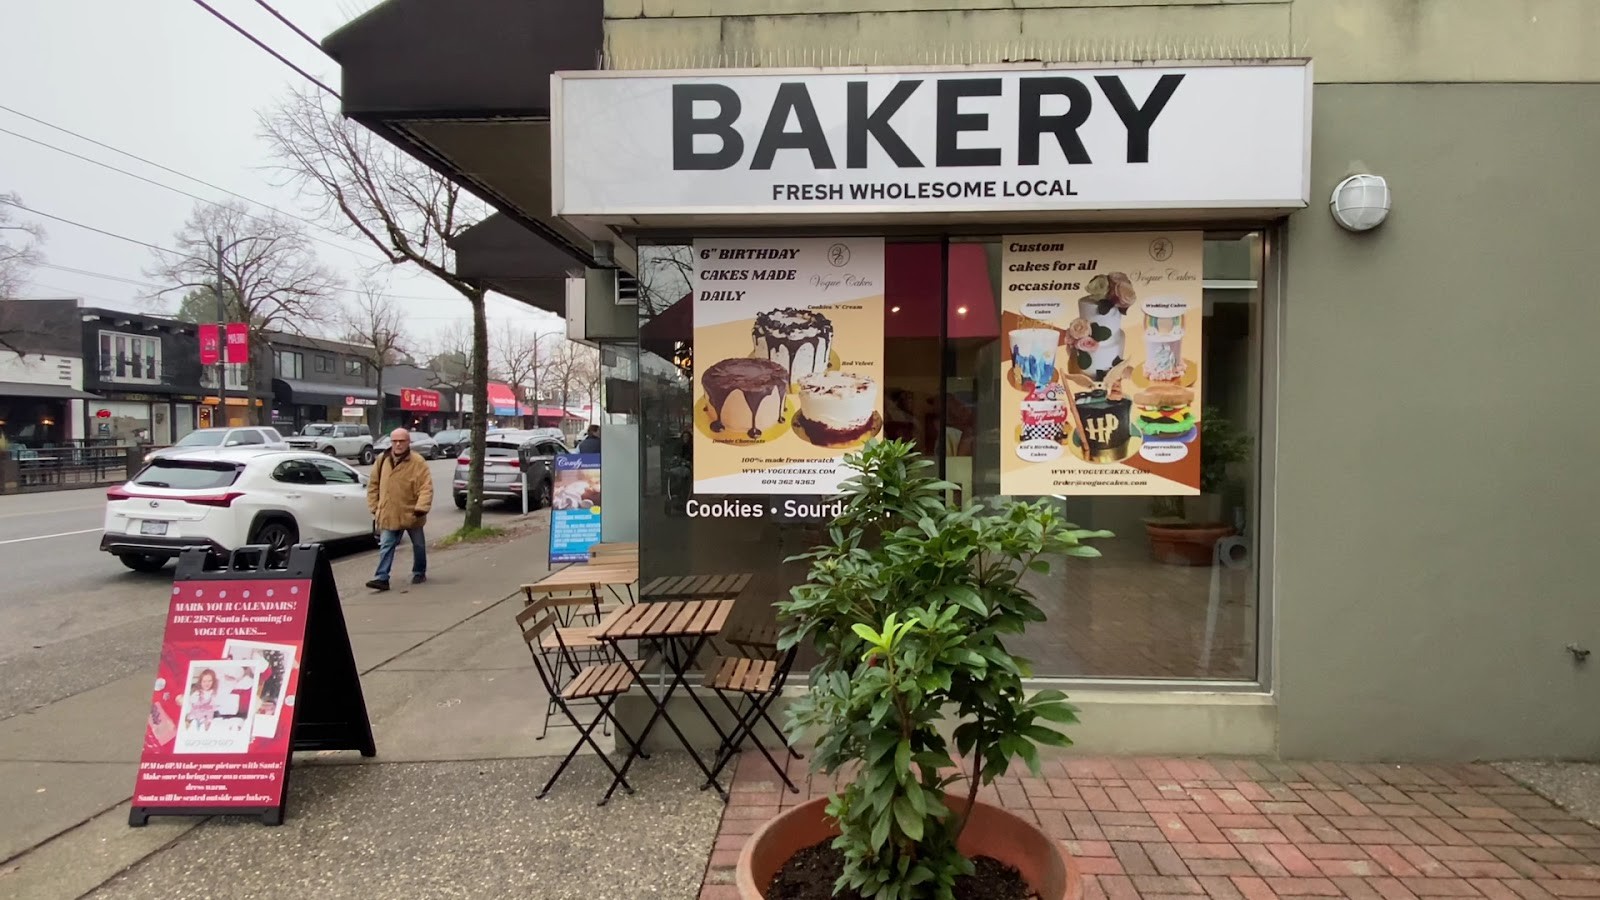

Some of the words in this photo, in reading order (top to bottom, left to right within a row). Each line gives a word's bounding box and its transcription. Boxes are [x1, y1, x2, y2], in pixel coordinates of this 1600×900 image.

[672, 74, 1186, 171] BAKERY
[773, 184, 843, 200] FRESH
[849, 181, 996, 199] WHOLESOME
[1003, 179, 1078, 197] LOCAL
[1009, 242, 1065, 253] Custom
[719, 249, 800, 260] BIRTHDAY
[1008, 261, 1050, 272] cakes
[1052, 261, 1076, 272] for
[1077, 259, 1098, 271] all
[700, 269, 749, 281] CAKES
[751, 269, 797, 280] MADE
[1008, 281, 1081, 292] occasions
[700, 290, 746, 301] DAILY
[686, 500, 764, 517] Cookies
[175, 602, 204, 612] MARK
[205, 602, 233, 611] YOUR
[233, 601, 297, 611] CALENDARS!
[173, 615, 193, 624] DEC
[193, 615, 215, 623] 21ST
[215, 615, 240, 623] Santa
[241, 614, 249, 622] is
[249, 613, 283, 624] coming
[282, 614, 293, 622] to
[193, 627, 226, 636] VOGUE
